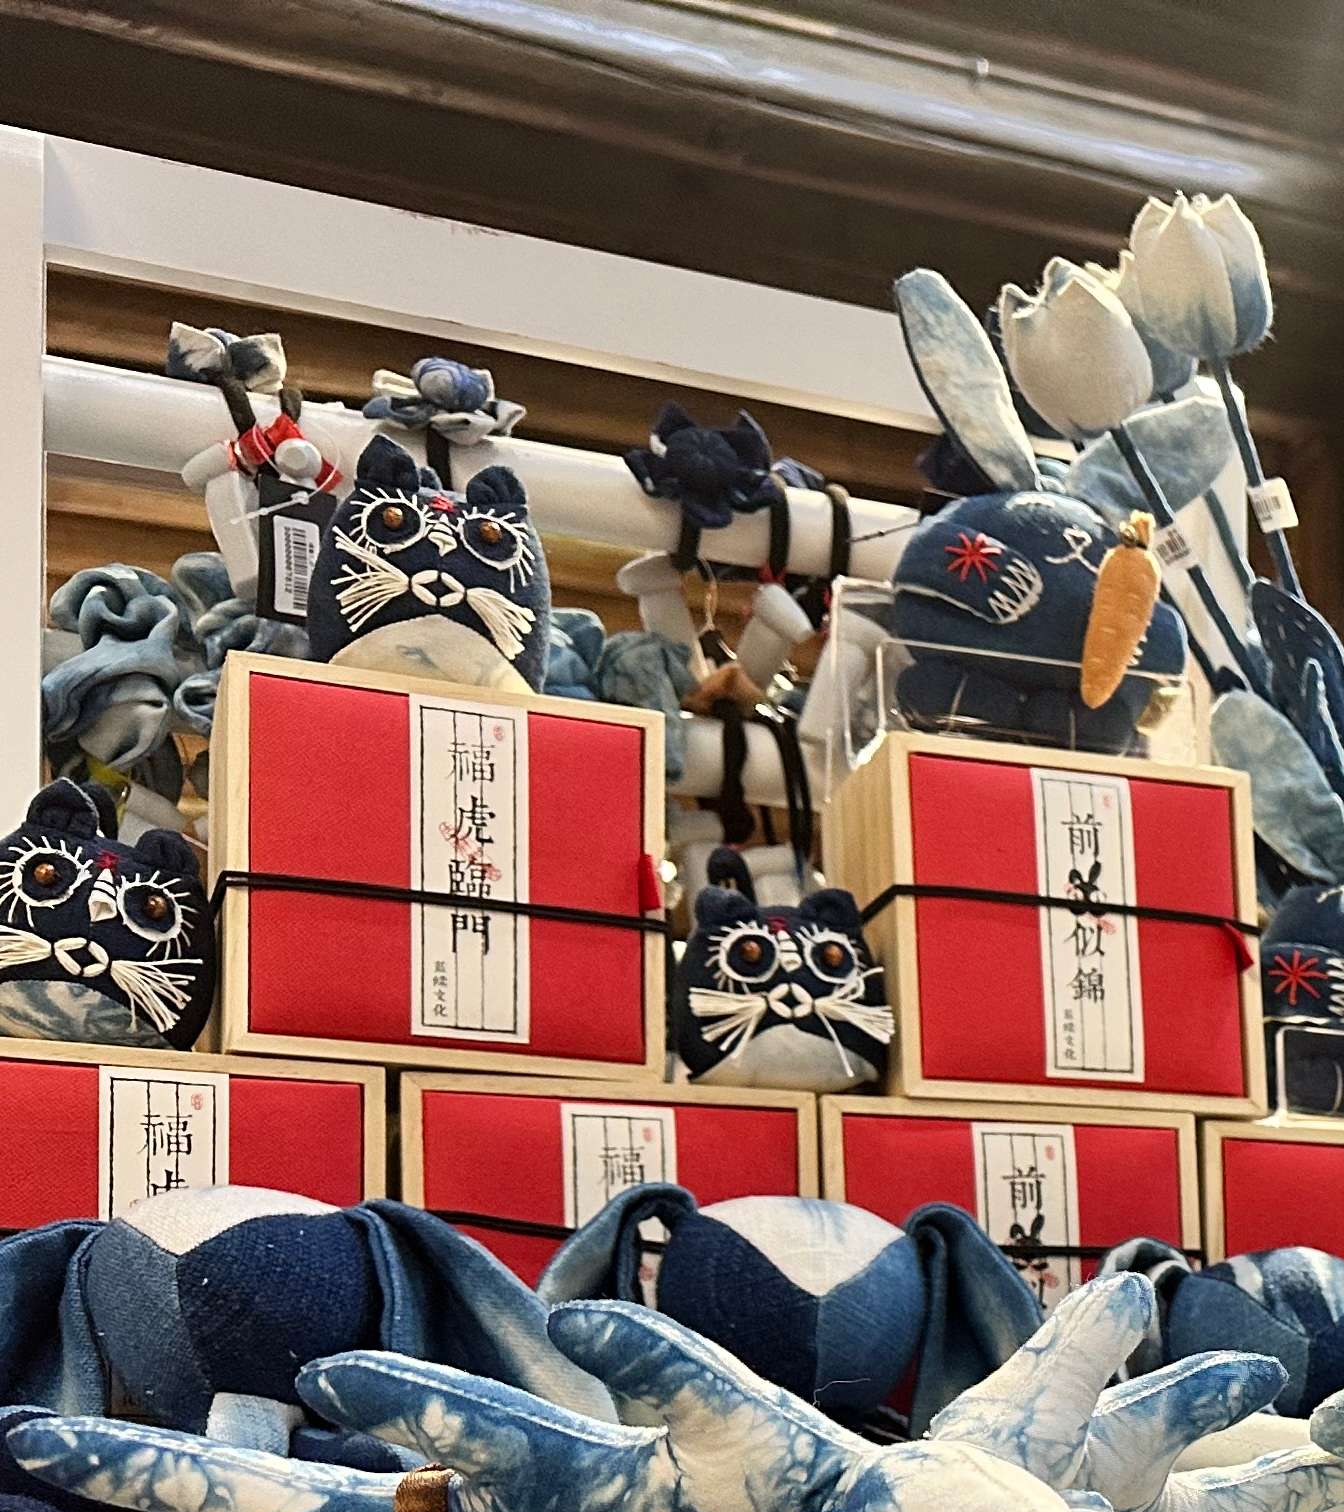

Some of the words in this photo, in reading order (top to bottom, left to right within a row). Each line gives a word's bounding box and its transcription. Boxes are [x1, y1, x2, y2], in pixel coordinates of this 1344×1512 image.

[448, 741, 496, 956] 福虎臨門
[598, 1146, 645, 1185] 福
[1002, 1166, 1046, 1209] 前
